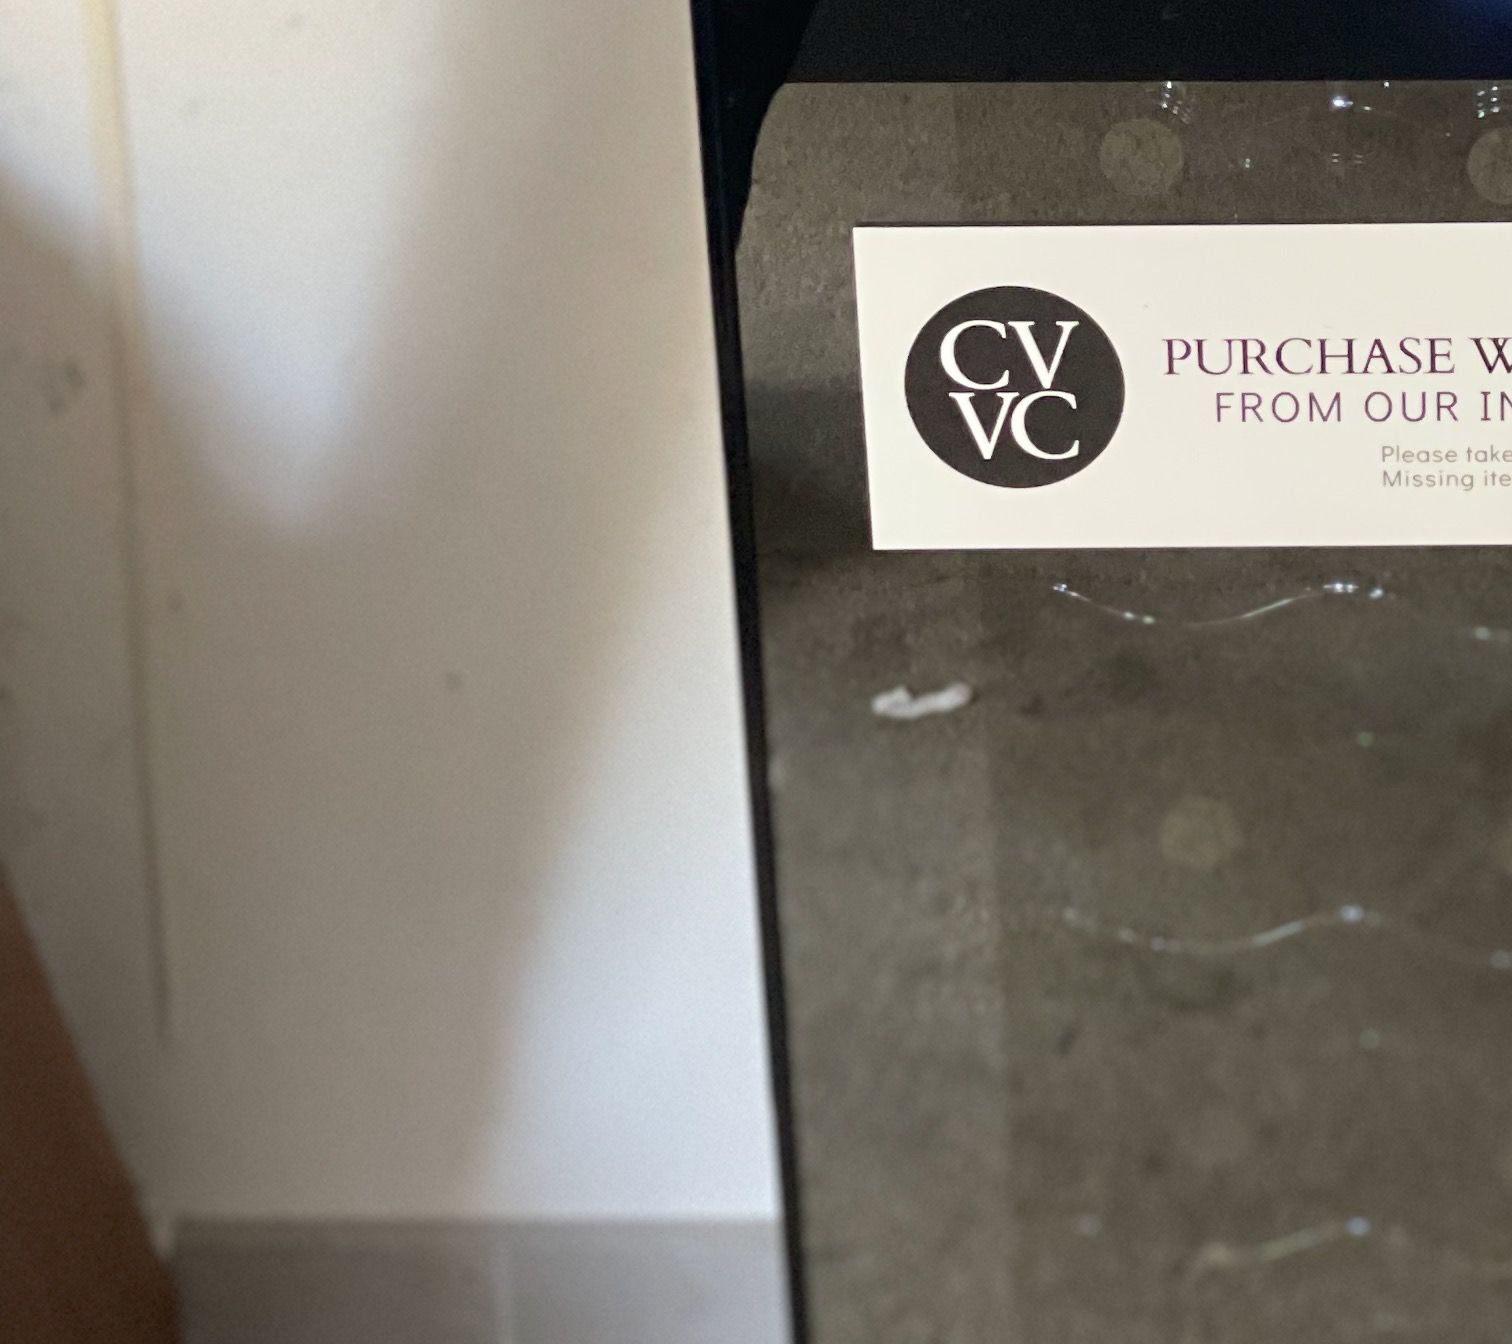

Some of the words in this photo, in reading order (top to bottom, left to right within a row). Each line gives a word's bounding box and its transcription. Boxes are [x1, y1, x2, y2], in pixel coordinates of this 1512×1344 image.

[939, 319, 1080, 390] CV
[1161, 336, 1456, 376] PURCHASE
[948, 390, 1080, 461] VC
[1215, 391, 1343, 424] FROM
[1363, 390, 1459, 423] OUR
[1380, 444, 1458, 463] Please
[1381, 469, 1475, 492] Missing
